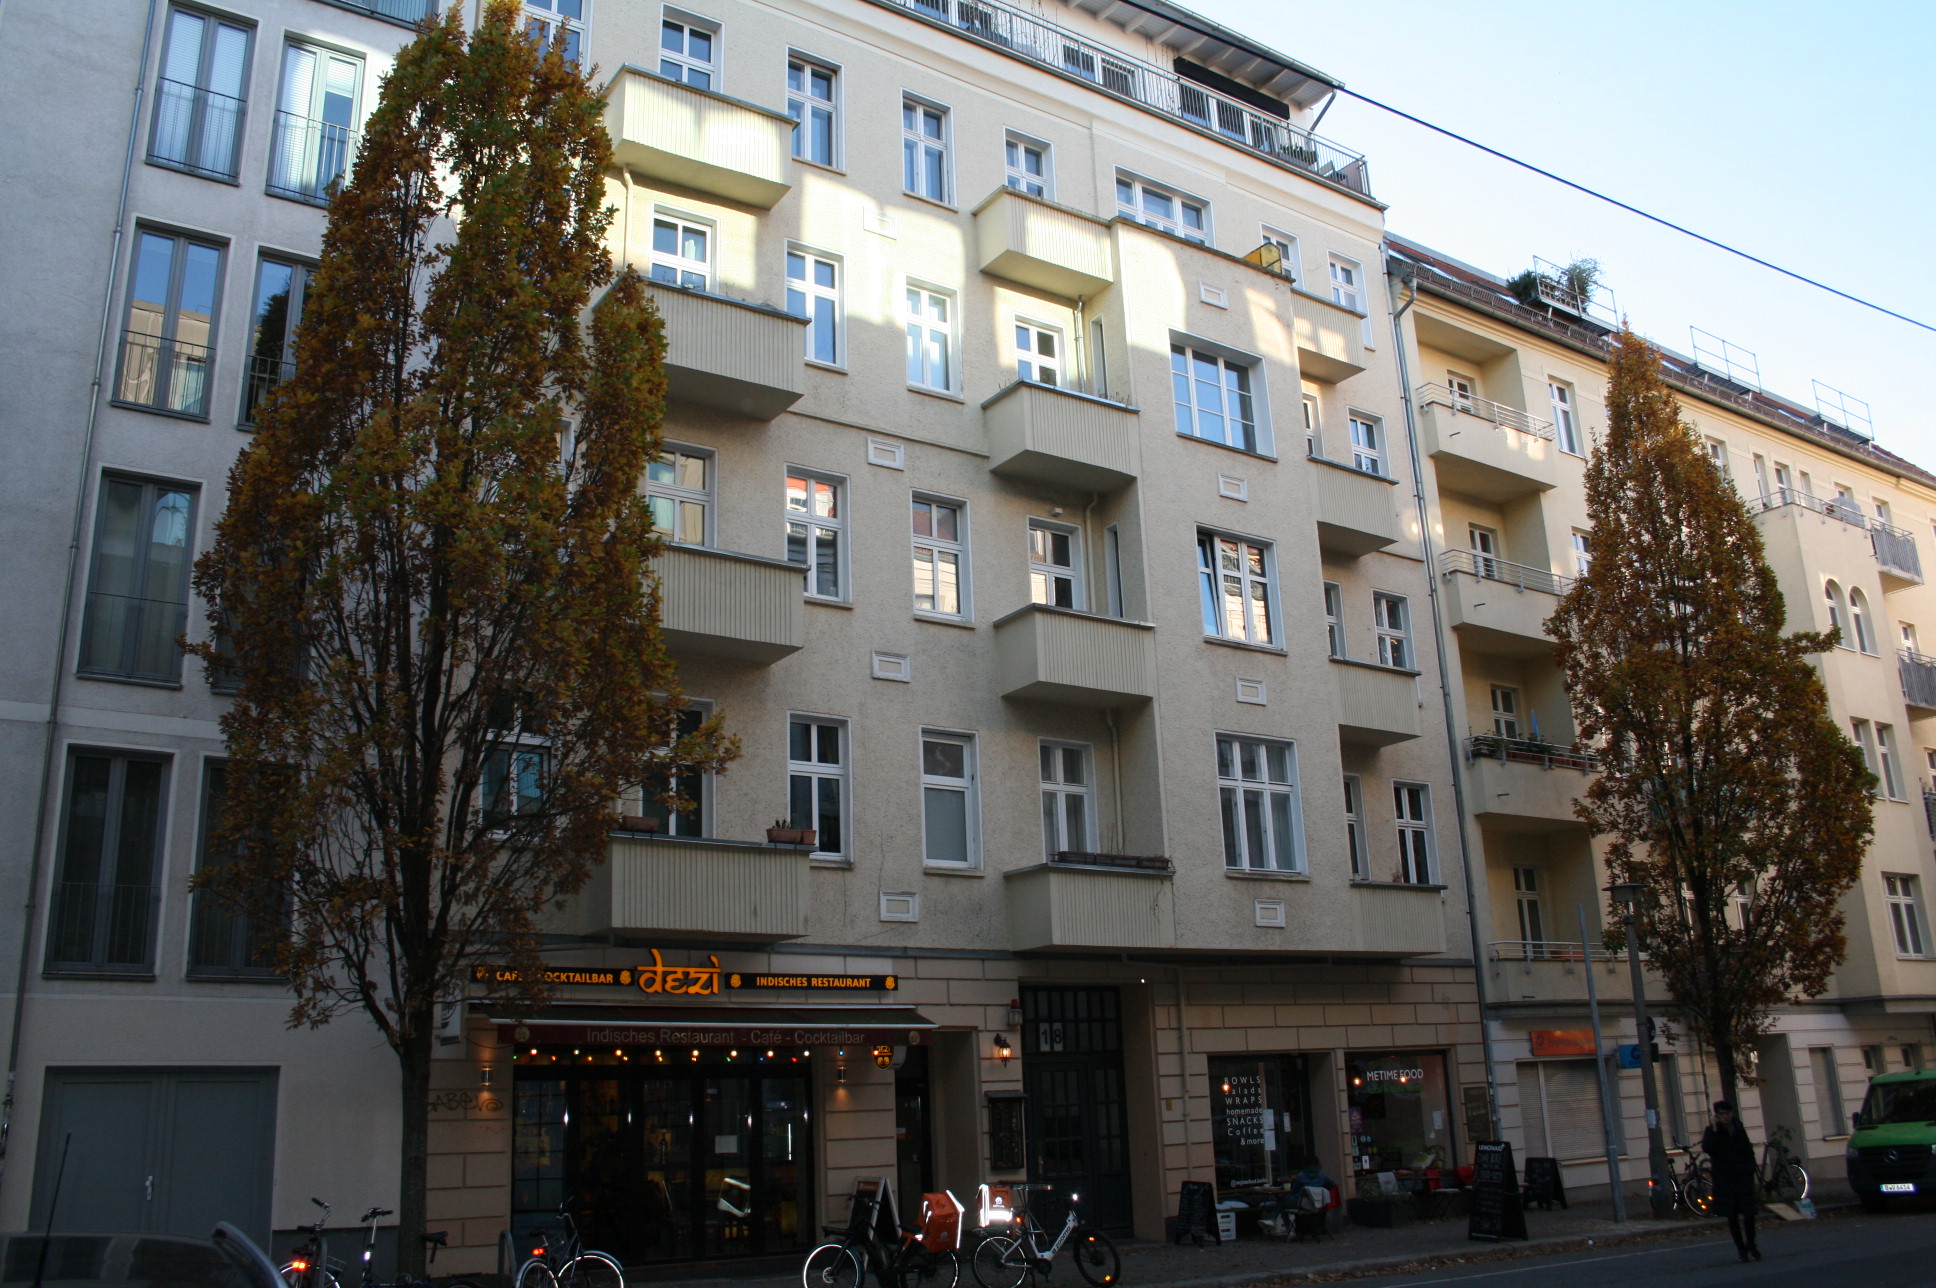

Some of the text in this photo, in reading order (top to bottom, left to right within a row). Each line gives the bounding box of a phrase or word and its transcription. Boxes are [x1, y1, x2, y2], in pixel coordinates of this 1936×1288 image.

[495, 970, 614, 984] CAF OCKTAILBAR
[755, 975, 872, 989] INDISCHES RESTAURANT
[587, 1027, 656, 1044] Indisches
[660, 1027, 736, 1045] Restaurant
[750, 1028, 783, 1044] Café
[794, 1029, 865, 1045] Cocktailbar
[1041, 1028, 1062, 1044] 18
[1224, 1075, 1261, 1085] BOWLS
[1366, 1068, 1424, 1081] METIME FOOD
[1225, 1095, 1262, 1105] WRAPS
[1226, 1106, 1263, 1116] homemade
[1226, 1115, 1264, 1126] SNACKS
[1227, 1126, 1265, 1136] Coffee
